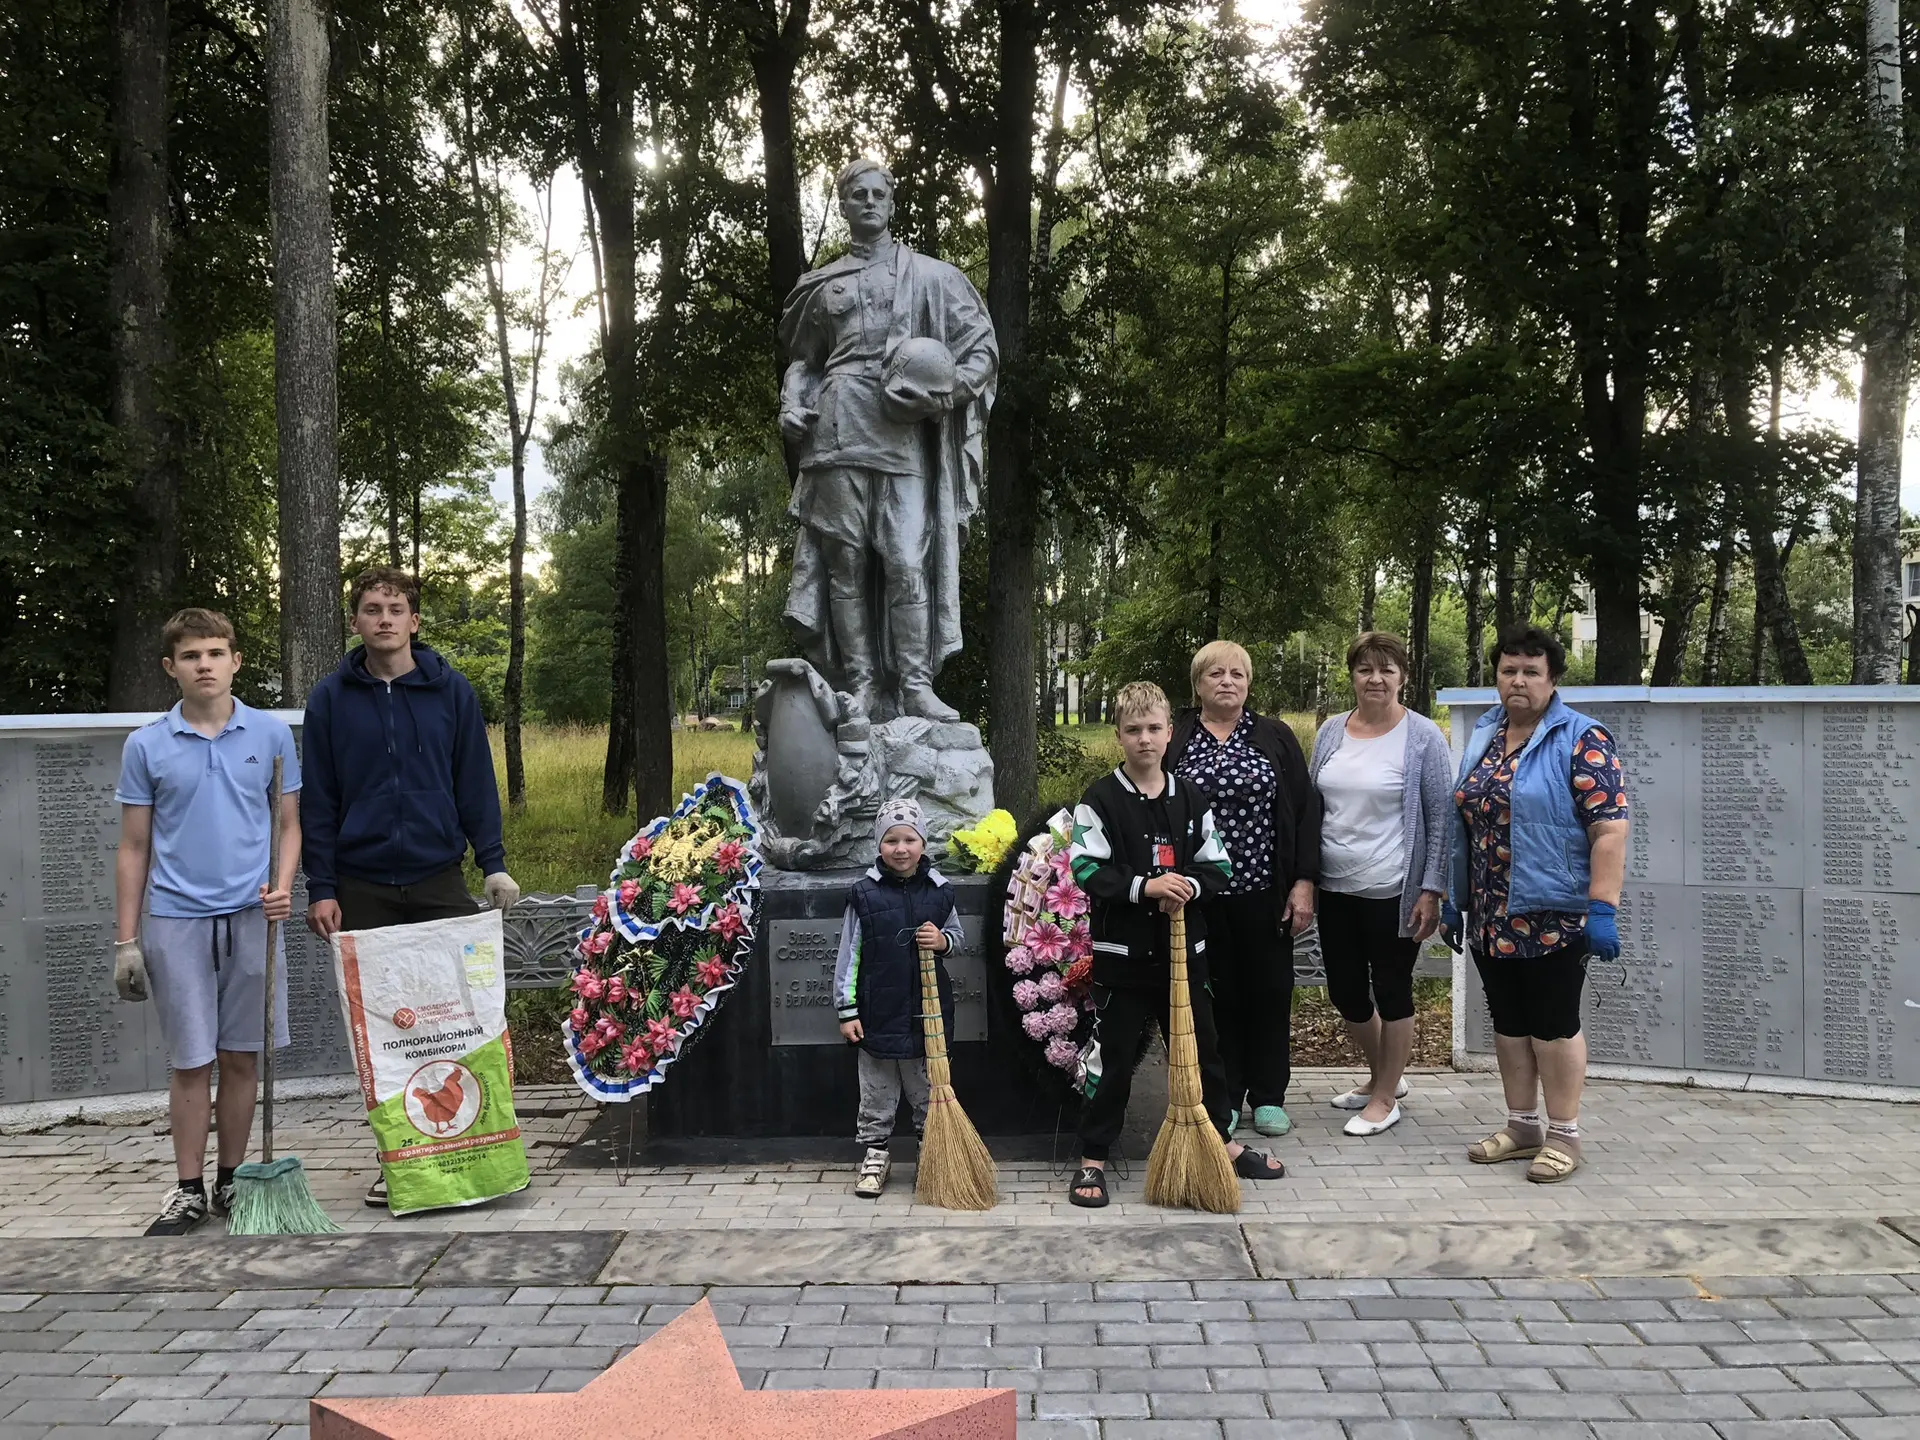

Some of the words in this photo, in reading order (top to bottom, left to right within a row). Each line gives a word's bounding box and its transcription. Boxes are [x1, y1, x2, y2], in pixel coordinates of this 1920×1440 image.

[788, 930, 827, 945] ЗДЕСЬ
[777, 945, 839, 960] СОВЕТСКО
[790, 979, 800, 991] С
[805, 979, 833, 992] ВРАГ
[785, 991, 834, 1008] ВЕЛИКО
[383, 1025, 484, 1051] ПОЛНОРАЦИОННЫЙ
[405, 1043, 467, 1060] КОМБИКОРМ
[398, 1139, 470, 1158] гарантированный
[470, 1132, 507, 1147] результат
[401, 1138, 413, 1148] 25
